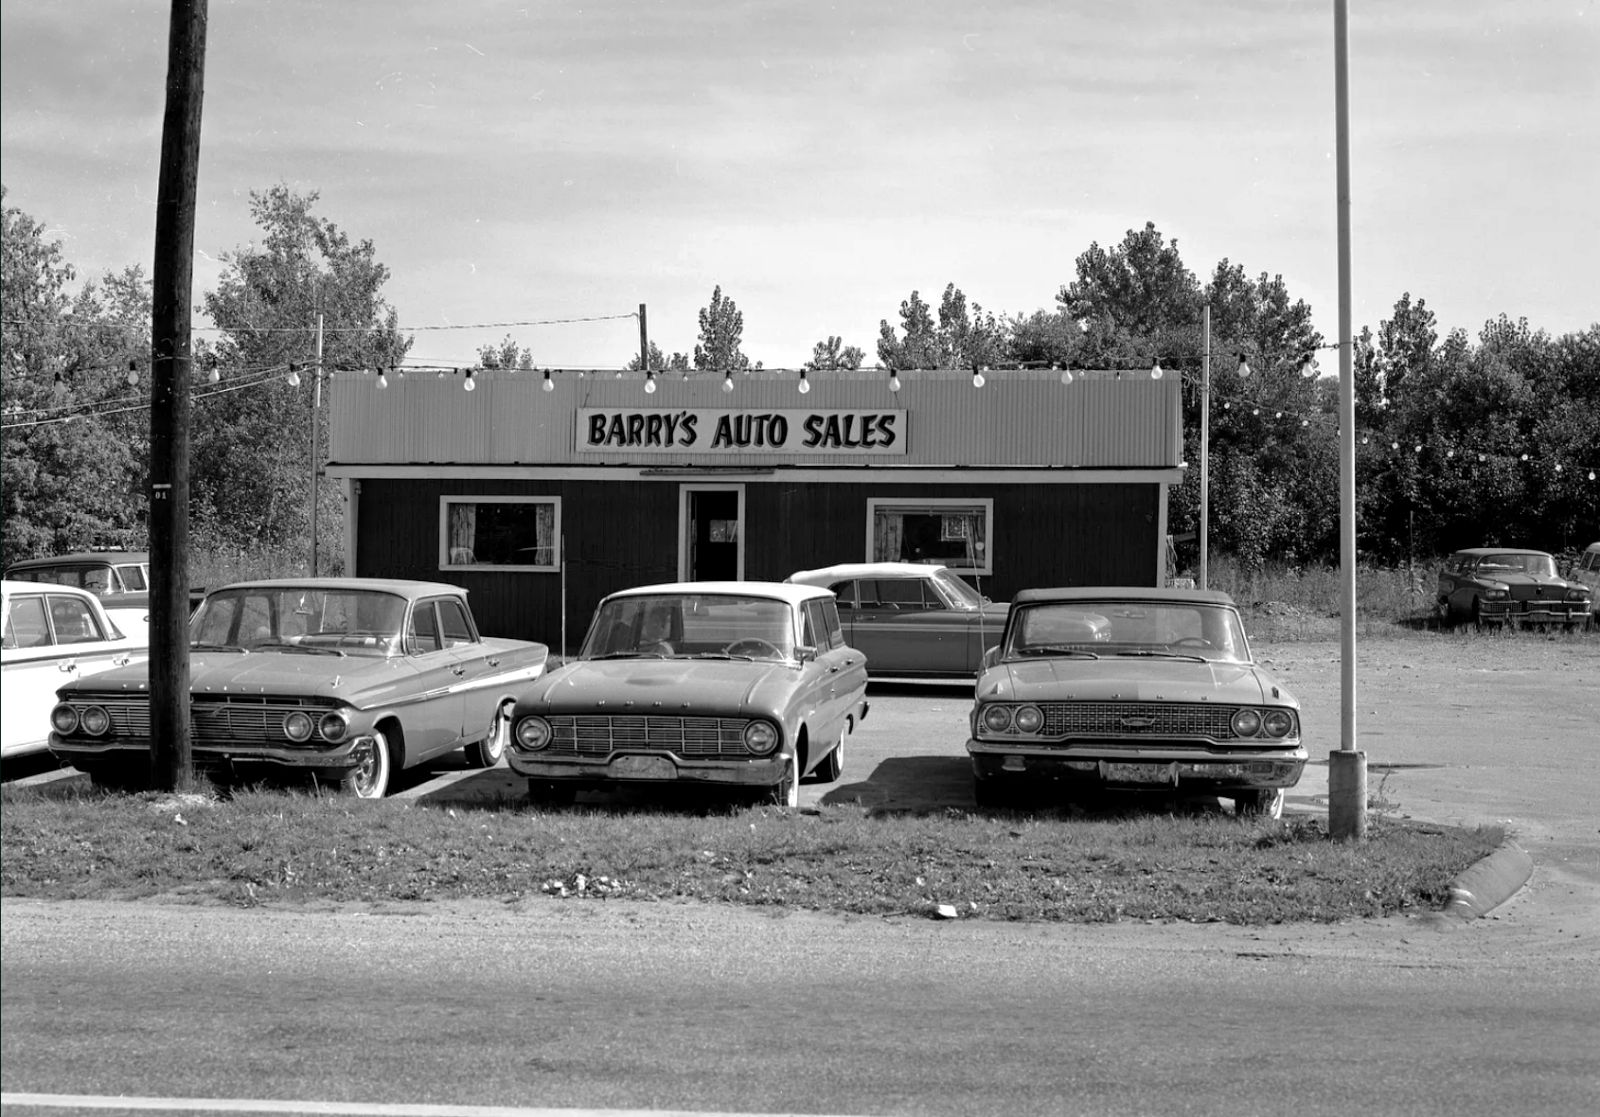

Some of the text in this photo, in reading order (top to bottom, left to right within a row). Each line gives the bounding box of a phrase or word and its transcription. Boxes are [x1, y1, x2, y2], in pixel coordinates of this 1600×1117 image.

[587, 411, 896, 448] BARRY'S AUTO SALES
